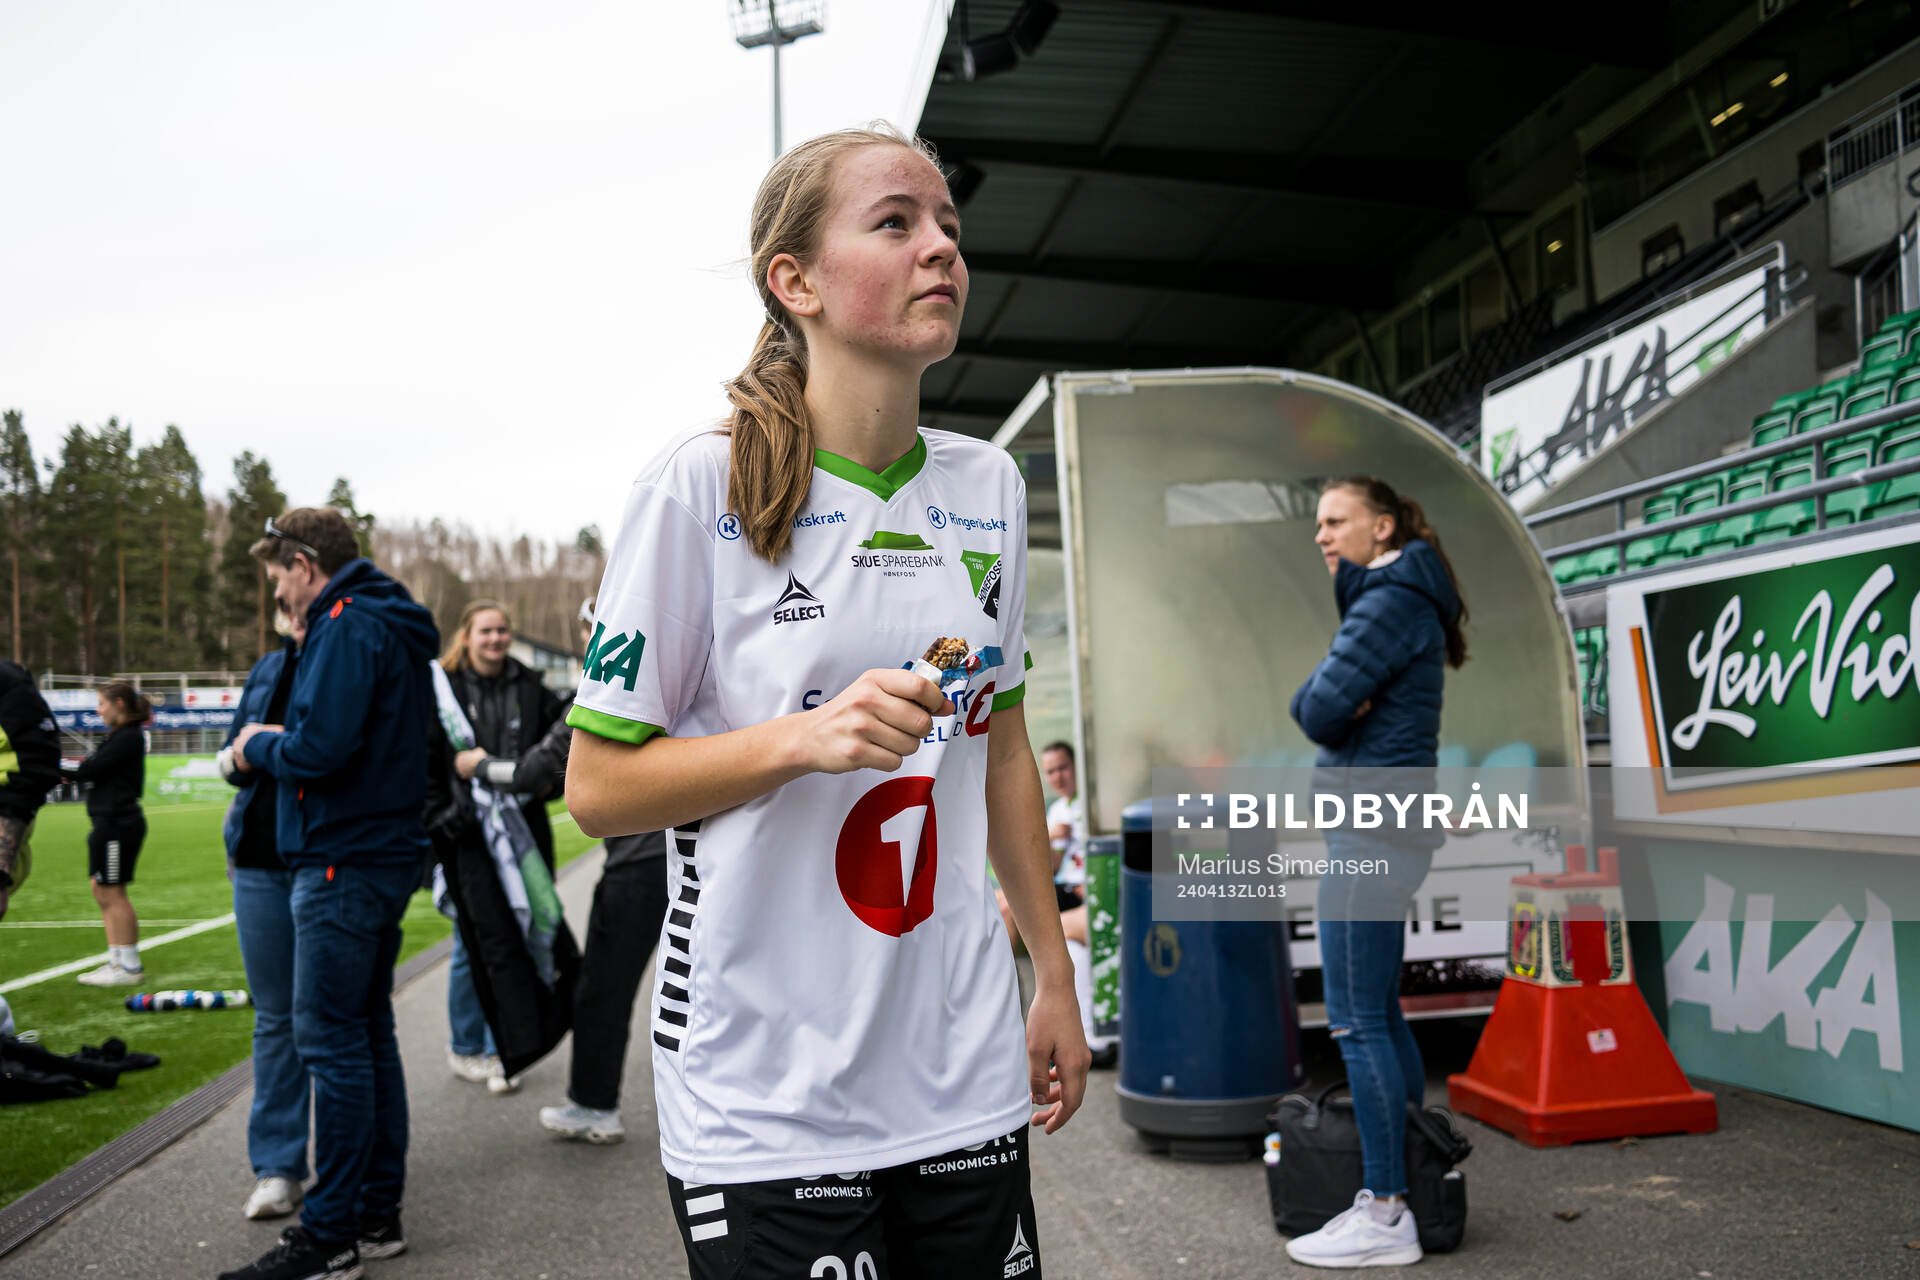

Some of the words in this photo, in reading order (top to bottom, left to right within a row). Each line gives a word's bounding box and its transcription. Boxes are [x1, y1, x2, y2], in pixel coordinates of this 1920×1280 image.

[1541, 325, 1674, 479] AKA
[793, 510, 847, 529] ikskraft
[851, 555, 881, 568] SKUE
[882, 555, 946, 568] SPAREBANK
[773, 605, 825, 625] SELECT
[1671, 595, 1807, 750] Leiv
[1664, 872, 1904, 1073] AKA
[920, 1154, 998, 1175] ECONOMICS
[1000, 1152, 1008, 1164] &
[1010, 1150, 1018, 1161] IT
[795, 1186, 863, 1199] ECONOMICS
[1003, 1253, 1034, 1279] SELECT
